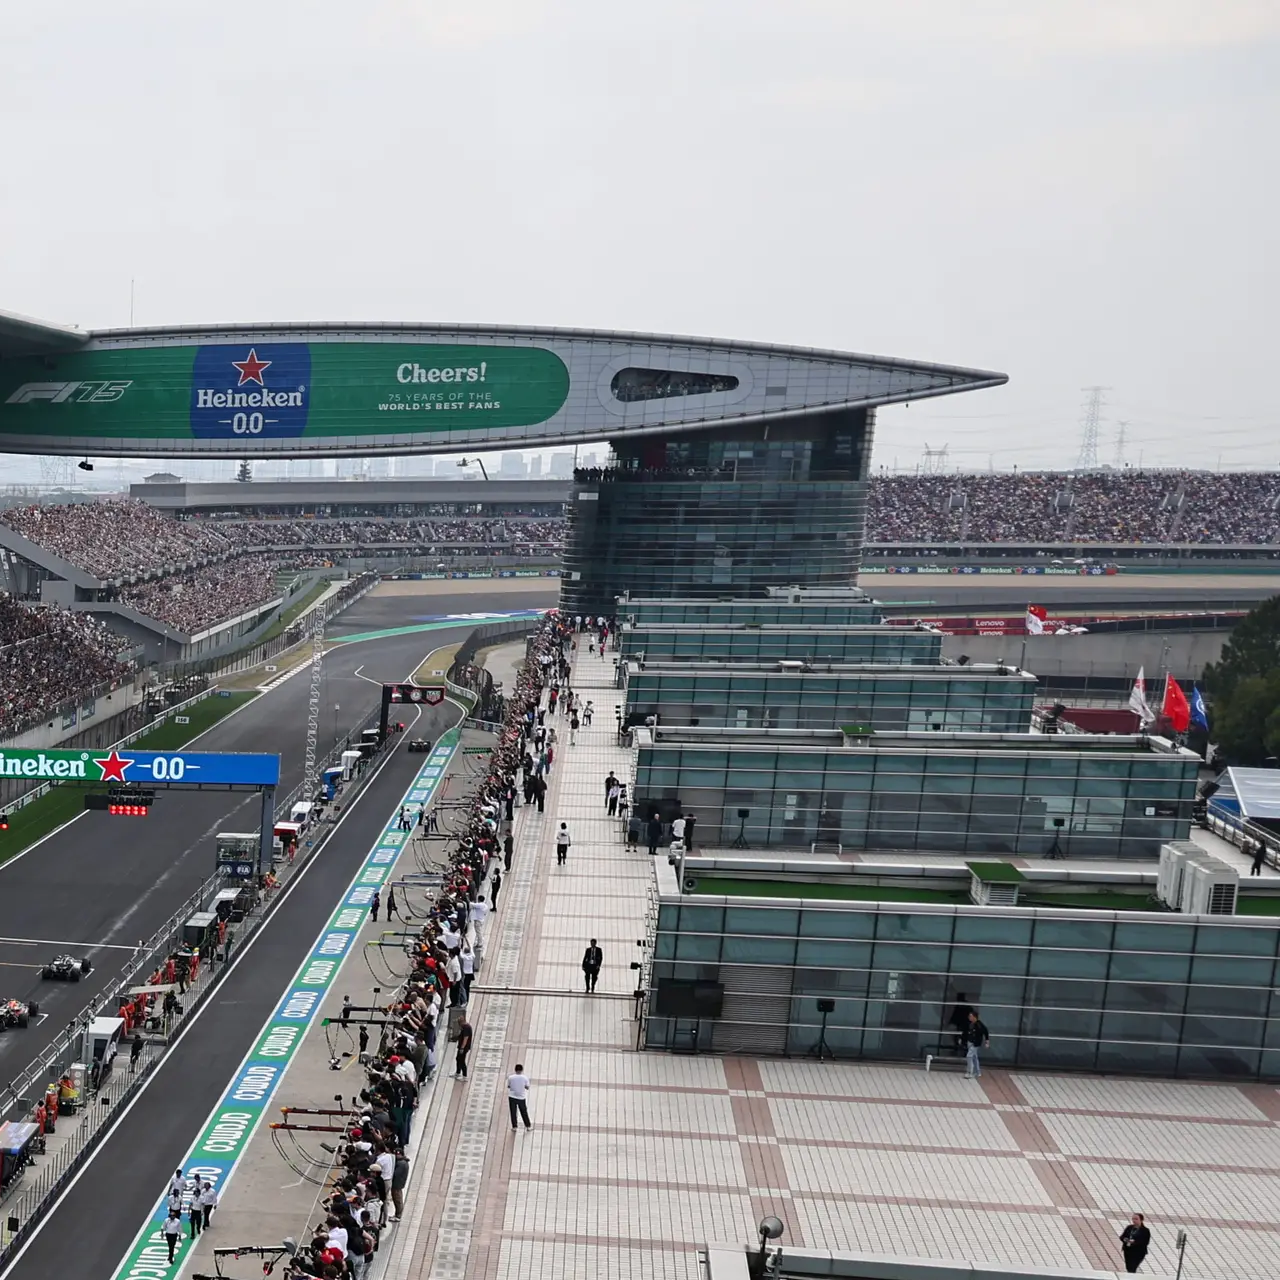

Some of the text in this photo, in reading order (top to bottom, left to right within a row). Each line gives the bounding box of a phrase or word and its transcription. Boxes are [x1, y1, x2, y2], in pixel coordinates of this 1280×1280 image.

[397, 362, 487, 383] Cheers!
[196, 388, 303, 408] Heineken
[378, 401, 500, 410] WORLD'S BEST FANS
[233, 1066, 277, 1101] aramco
[201, 1112, 252, 1152] aramco
